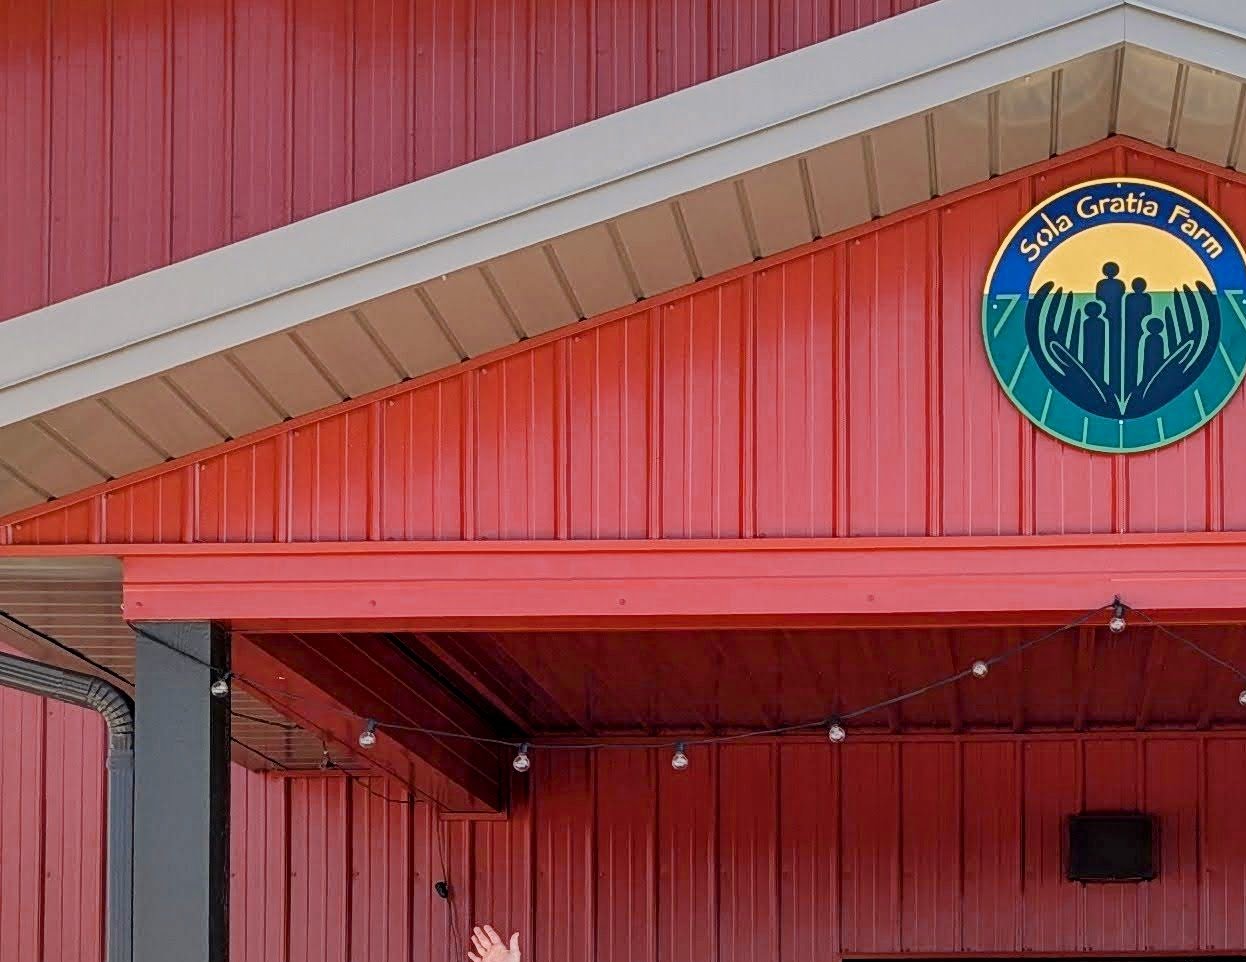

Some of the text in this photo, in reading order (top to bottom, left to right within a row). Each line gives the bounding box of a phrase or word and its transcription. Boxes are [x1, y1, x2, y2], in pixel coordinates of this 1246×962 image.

[1020, 191, 1223, 262] Sola Gratia Farm
